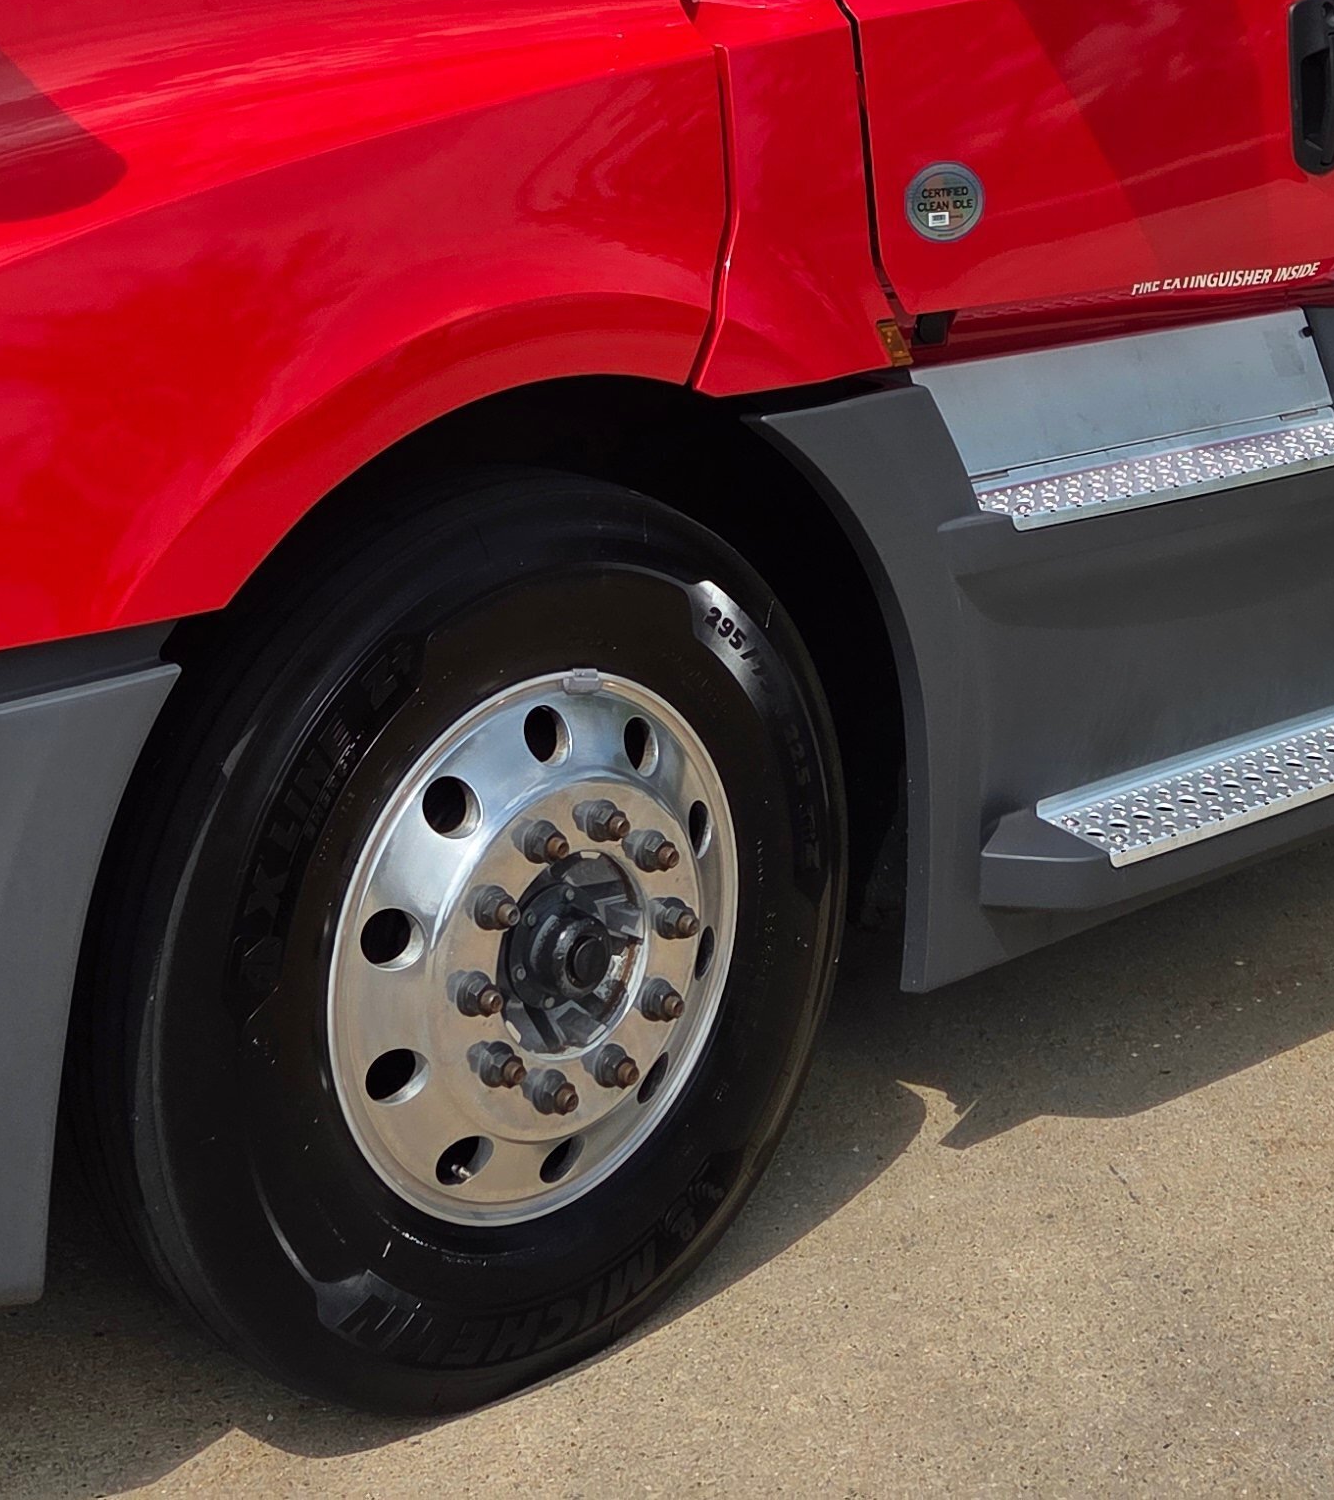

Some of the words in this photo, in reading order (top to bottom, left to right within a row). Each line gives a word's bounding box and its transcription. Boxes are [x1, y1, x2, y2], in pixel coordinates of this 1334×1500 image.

[921, 186, 968, 199] CERTIFIED
[917, 201, 949, 212] CLEAN
[953, 199, 973, 210] IDLE
[1273, 261, 1320, 282] INSIDE
